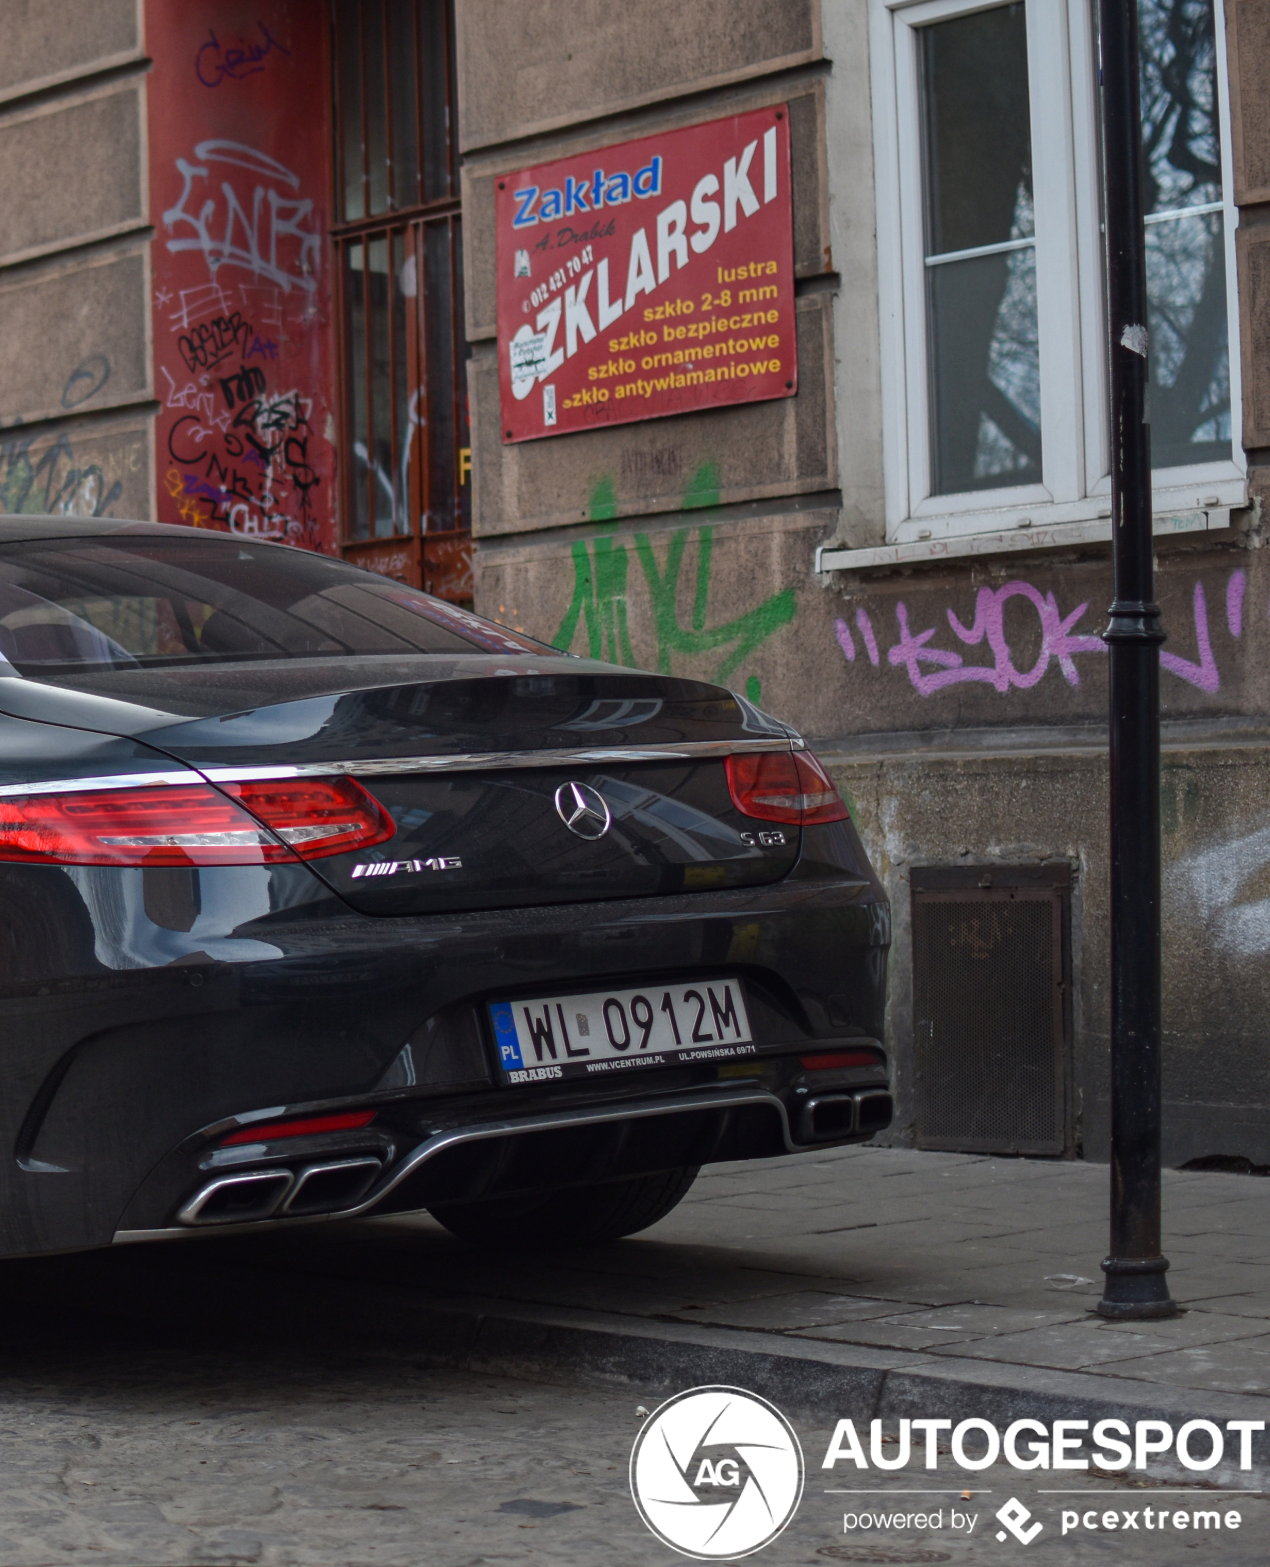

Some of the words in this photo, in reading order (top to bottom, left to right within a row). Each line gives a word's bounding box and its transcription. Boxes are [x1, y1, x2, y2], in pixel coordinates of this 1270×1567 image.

[512, 155, 662, 229] Zakład
[531, 282, 549, 308] 012
[550, 267, 568, 292] 421
[566, 256, 582, 278] 70
[581, 244, 594, 265] 47
[717, 260, 778, 284] lustra
[643, 298, 695, 322] szkło
[701, 289, 732, 312] 2-8
[738, 285, 778, 303] mm
[609, 329, 658, 353] szkło
[663, 309, 780, 342] bezpieczne
[588, 357, 637, 380] szkło
[641, 334, 781, 370] ornamentowe
[615, 358, 781, 398] antywłamaniowe
[741, 832, 756, 846] S
[759, 831, 787, 846] 63
[390, 856, 463, 875] AMG
[523, 1003, 590, 1061] WL
[602, 985, 742, 1051] 0912M
[501, 1045, 519, 1060] PL
[586, 1056, 666, 1072] WWW.VCENTRUM.PL
[678, 1047, 736, 1061] UL.POWSIŃSKA
[736, 1044, 756, 1055] 69/71
[509, 1065, 563, 1084] BRABUS
